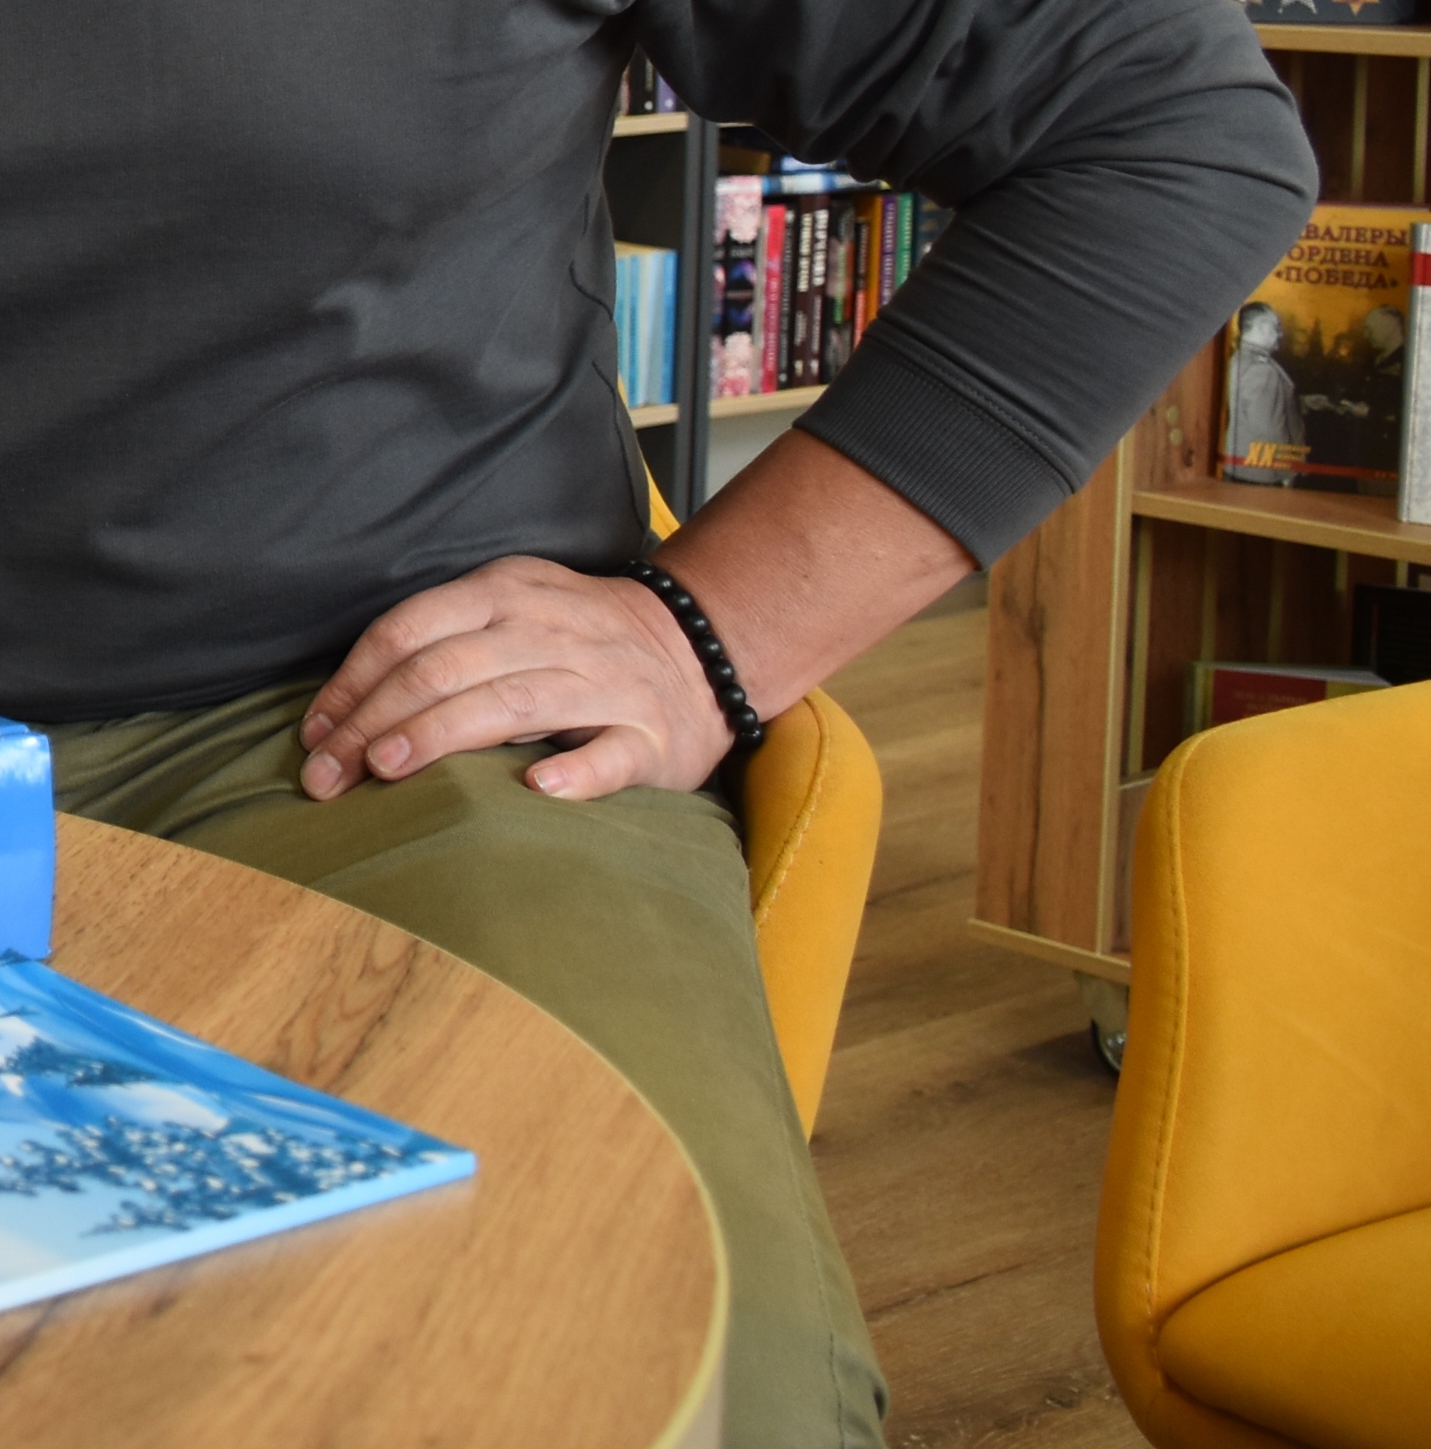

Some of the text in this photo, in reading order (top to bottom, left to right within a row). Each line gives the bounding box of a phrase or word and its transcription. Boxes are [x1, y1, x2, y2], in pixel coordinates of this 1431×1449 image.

[1300, 223, 1408, 245] ВАЛЕРЫ
[1288, 245, 1388, 267] ОРДЕНА
[1275, 266, 1398, 288] «ПОБЕДА»
